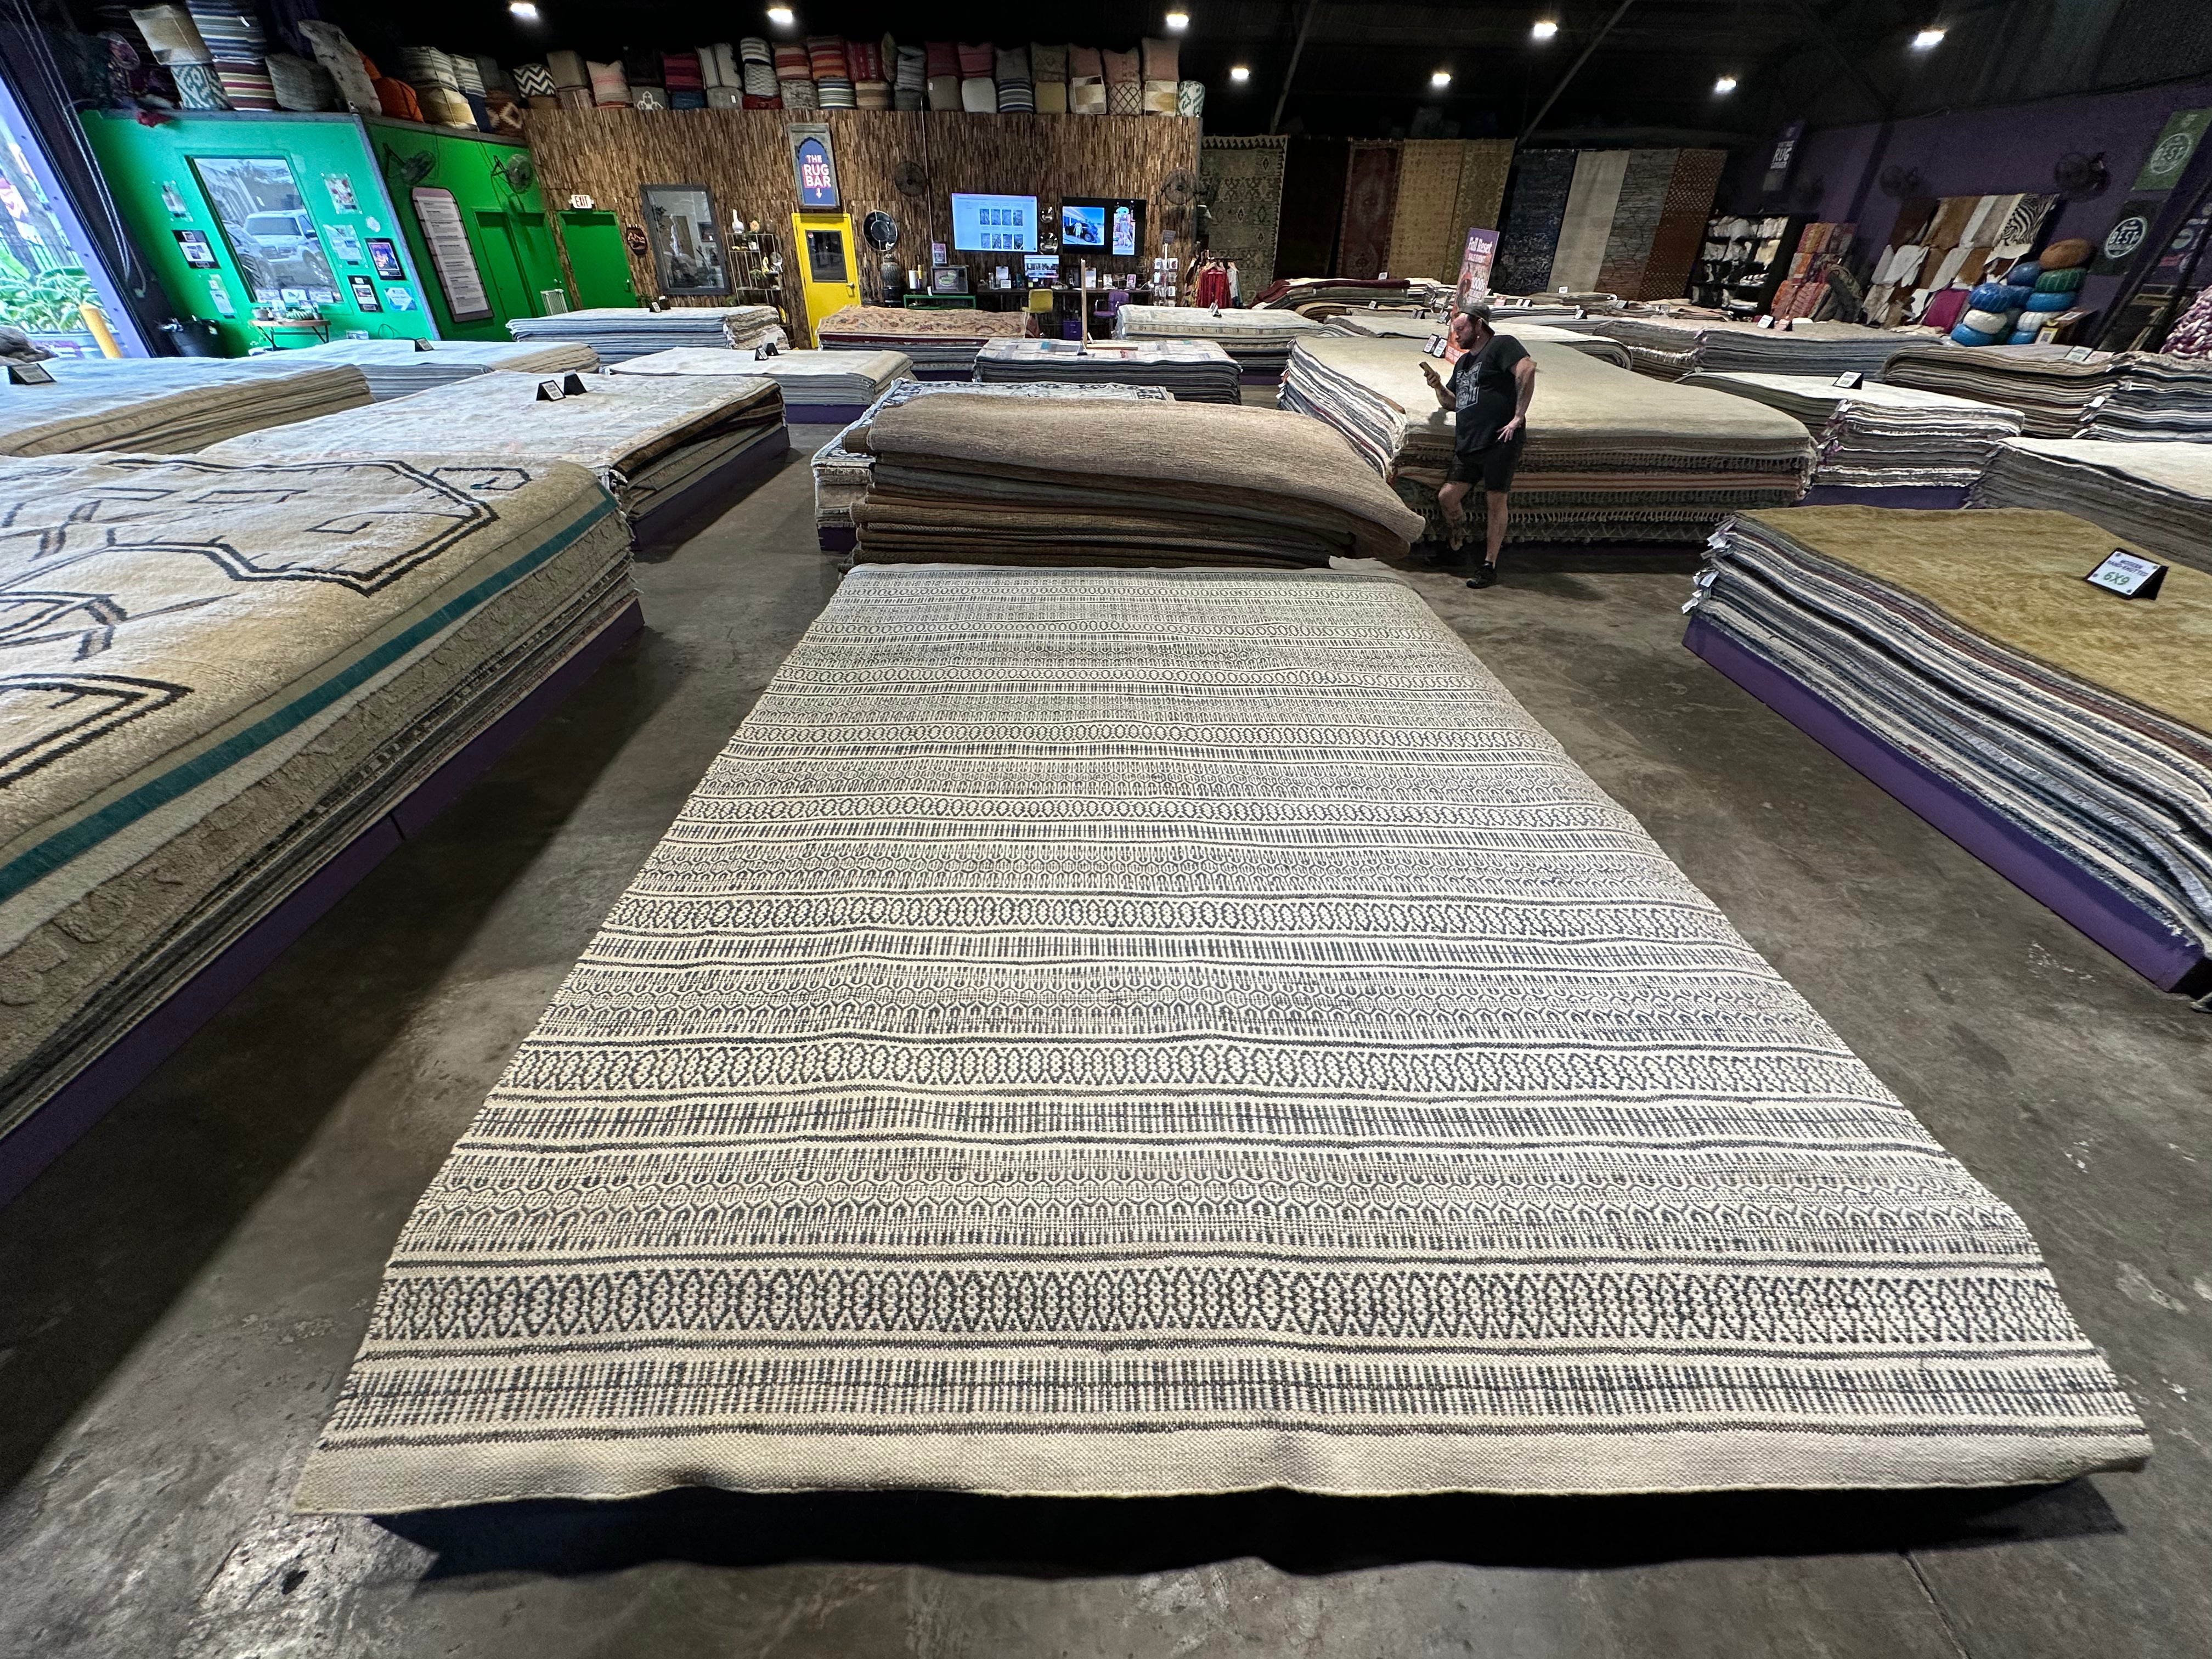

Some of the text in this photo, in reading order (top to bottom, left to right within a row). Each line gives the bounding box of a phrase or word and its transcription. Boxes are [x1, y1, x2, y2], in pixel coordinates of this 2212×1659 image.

[805, 155, 822, 163] THE
[1772, 147, 1792, 162] RUG
[803, 163, 830, 176] RUG
[805, 175, 832, 187] BAR
[574, 195, 589, 207] EXIT
[2108, 231, 2139, 244] BEST
[2103, 571, 2131, 585] 6X9
